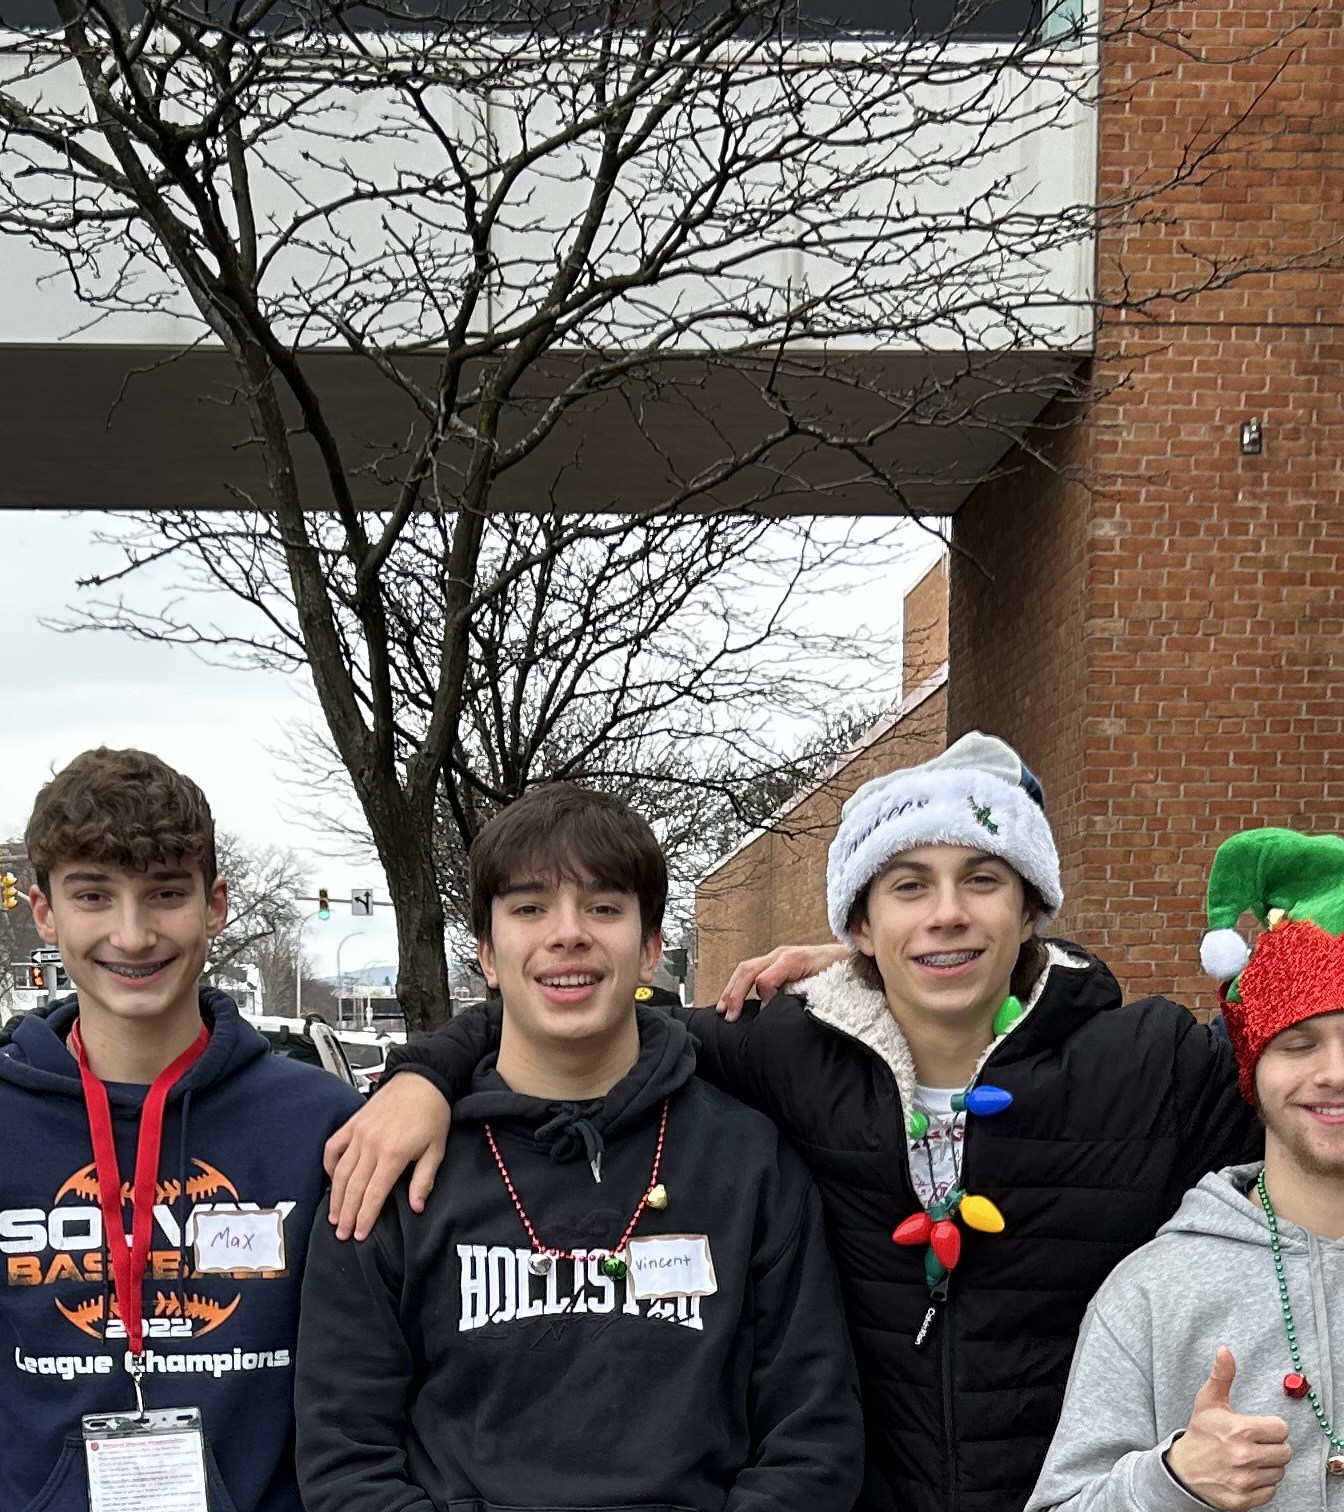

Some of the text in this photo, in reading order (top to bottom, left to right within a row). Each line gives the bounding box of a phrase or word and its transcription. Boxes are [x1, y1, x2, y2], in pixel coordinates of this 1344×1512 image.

[210, 1226, 256, 1252] Max
[15, 1347, 291, 1380] League Champions
